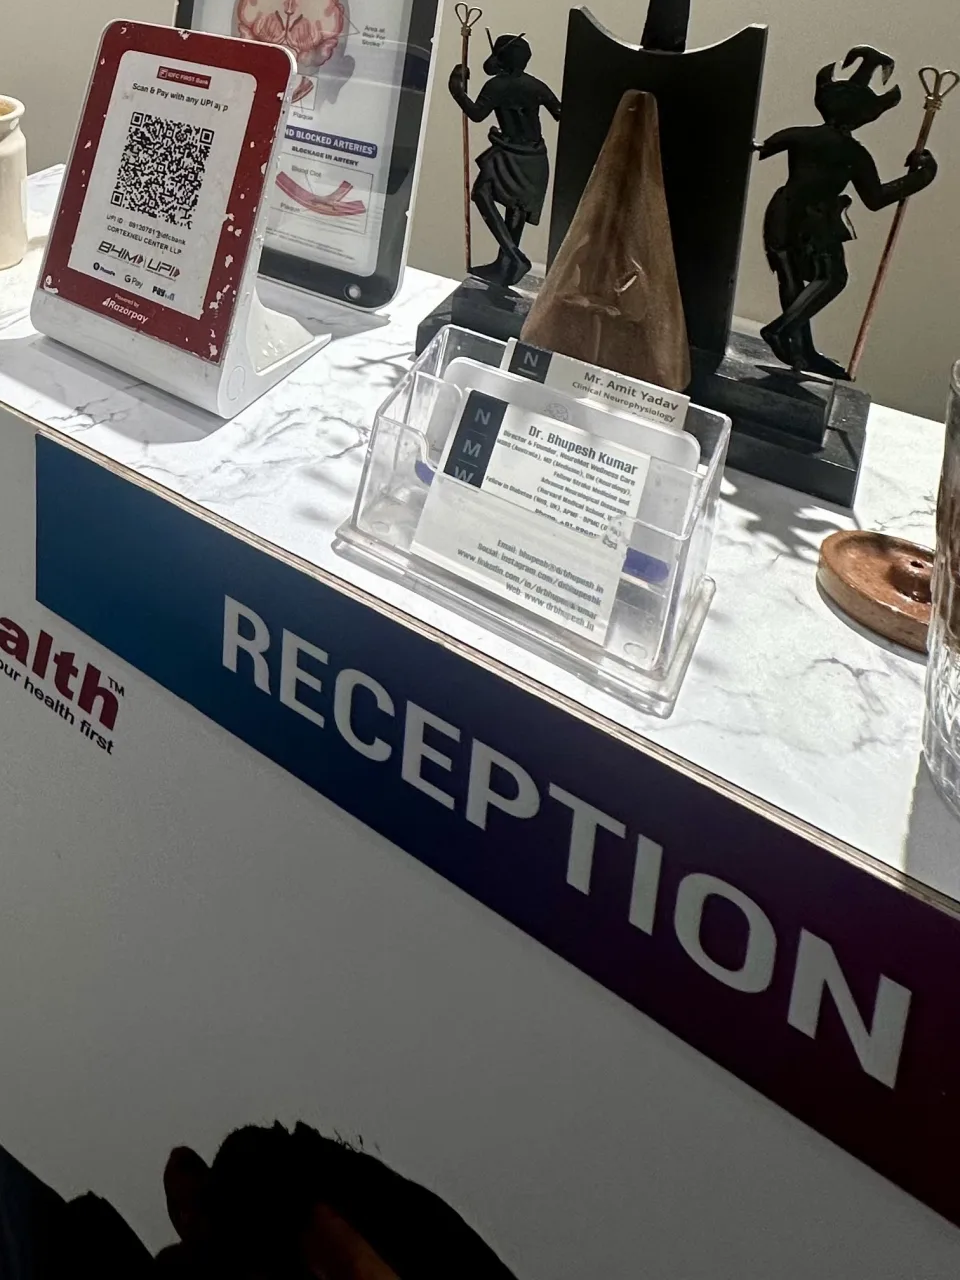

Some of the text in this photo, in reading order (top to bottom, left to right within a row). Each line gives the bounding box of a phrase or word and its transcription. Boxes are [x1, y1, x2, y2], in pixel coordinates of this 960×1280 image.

[132, 83, 149, 93] Scan
[156, 88, 169, 99] Pay
[170, 91, 185, 101] with
[186, 96, 199, 106] any
[200, 98, 213, 107] UPI
[292, 111, 314, 121] Plaque
[296, 131, 331, 145] BLOCKED
[291, 146, 324, 158] BLOCKAGE
[333, 156, 359, 166] ARTERY
[291, 165, 308, 175] Blood
[107, 225, 182, 255] CORTEXNEU CENTER LLP
[147, 258, 176, 277] UPI
[131, 276, 143, 289] Pay
[108, 299, 149, 324] Razorpay
[523, 351, 539, 367] N
[572, 381, 602, 397] Clinical
[603, 392, 676, 423] Neurophysiology
[584, 372, 679, 412] Mr. Amit Yadav
[474, 408, 491, 426] N
[462, 439, 481, 459] M
[503, 430, 528, 444] Director
[590, 463, 619, 480] Wellness
[620, 475, 636, 487] Care
[528, 425, 638, 475] Dr. Bhupesh Kumar
[453, 466, 474, 484] W
[485, 475, 503, 488] Fellow
[509, 485, 533, 500] Diabetes
[553, 471, 630, 506] Fellow Stroke Medicine and
[564, 486, 600, 505] Neurological
[562, 496, 584, 510] Medical
[497, 539, 518, 555] Email:
[506, 582, 522, 596] Web:
[107, 676, 125, 697] TM
[24, 676, 75, 726] health
[79, 719, 115, 756] first
[222, 594, 913, 1090] RECEPTION
